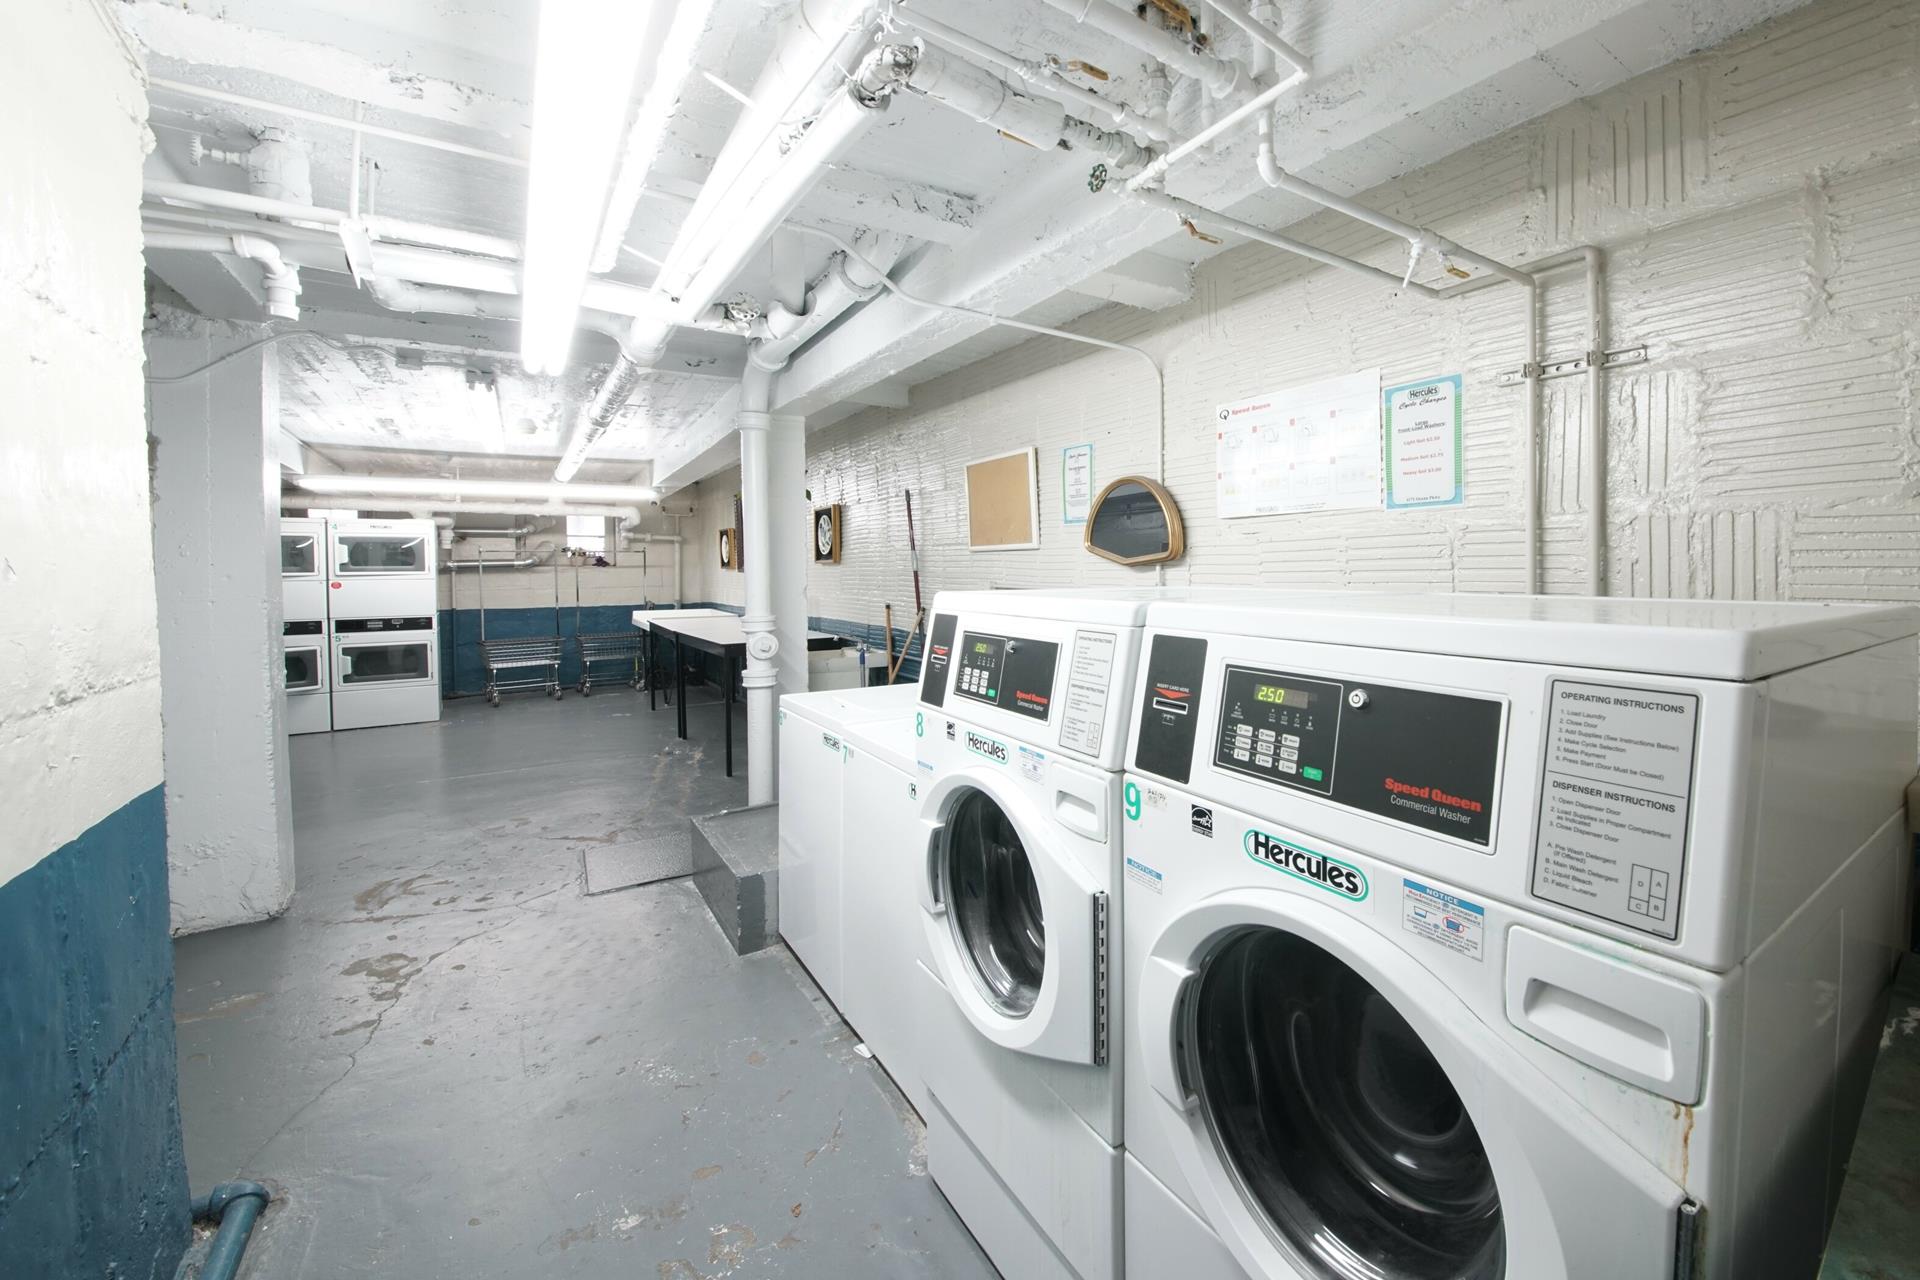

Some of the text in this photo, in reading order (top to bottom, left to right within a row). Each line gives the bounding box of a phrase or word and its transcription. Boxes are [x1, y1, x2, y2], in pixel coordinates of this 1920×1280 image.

[1410, 386, 1438, 398] Hercules
[1016, 690, 1032, 700] Speed
[1560, 691, 1686, 714] OPERATING INSTRUCTIONS
[916, 712, 924, 738] 8
[1566, 710, 1581, 718] Load
[1582, 712, 1606, 721] Laundry
[1566, 719, 1582, 727] Close
[967, 732, 1006, 760] Hercules
[1564, 738, 1580, 746] Make
[1581, 740, 1598, 749] Cycle
[1599, 743, 1626, 753] Selection
[1578, 730, 1602, 740] Supplies
[1604, 734, 1618, 742] (See
[1620, 736, 1655, 748] Instructions
[1656, 742, 1680, 752] Below)
[843, 744, 848, 764] 7
[1563, 747, 1579, 756] Make
[1580, 749, 1606, 760] Payment
[1562, 756, 1579, 765] Press
[1580, 759, 1594, 768] Start
[1595, 762, 1612, 771] (Door
[1614, 765, 1628, 774] Must
[1640, 770, 1664, 781] Closed)
[1124, 782, 1142, 821] 9
[1384, 778, 1482, 812] Speed Queen
[1552, 780, 1676, 813] DISPENSER INSTRUCTIONS
[1390, 794, 1472, 824] Commercial Washer
[1558, 797, 1574, 806] Open
[1576, 800, 1604, 812] Dispenser
[1606, 808, 1621, 816] Door
[1557, 808, 1572, 816] Load
[1573, 811, 1598, 822] Supplies
[1606, 818, 1626, 829] Proper
[1628, 824, 1672, 840] Compartment
[1565, 816, 1591, 827] Indicated
[1556, 822, 1572, 831] Close
[1574, 826, 1602, 838] Dispenser
[1604, 834, 1620, 842] Door
[1254, 831, 1359, 894] Hercules
[1561, 852, 1586, 864] Offered)
[1567, 847, 1584, 856] Wash
[1586, 852, 1616, 865] Detergent
[1552, 870, 1570, 880] Liquid
[1572, 875, 1592, 886] Bleach
[1553, 860, 1568, 868] Main
[1569, 864, 1586, 874] Wash
[1588, 870, 1618, 883] Detergent
[1552, 879, 1570, 889] Fabric
[1426, 888, 1460, 906] NOTICE
